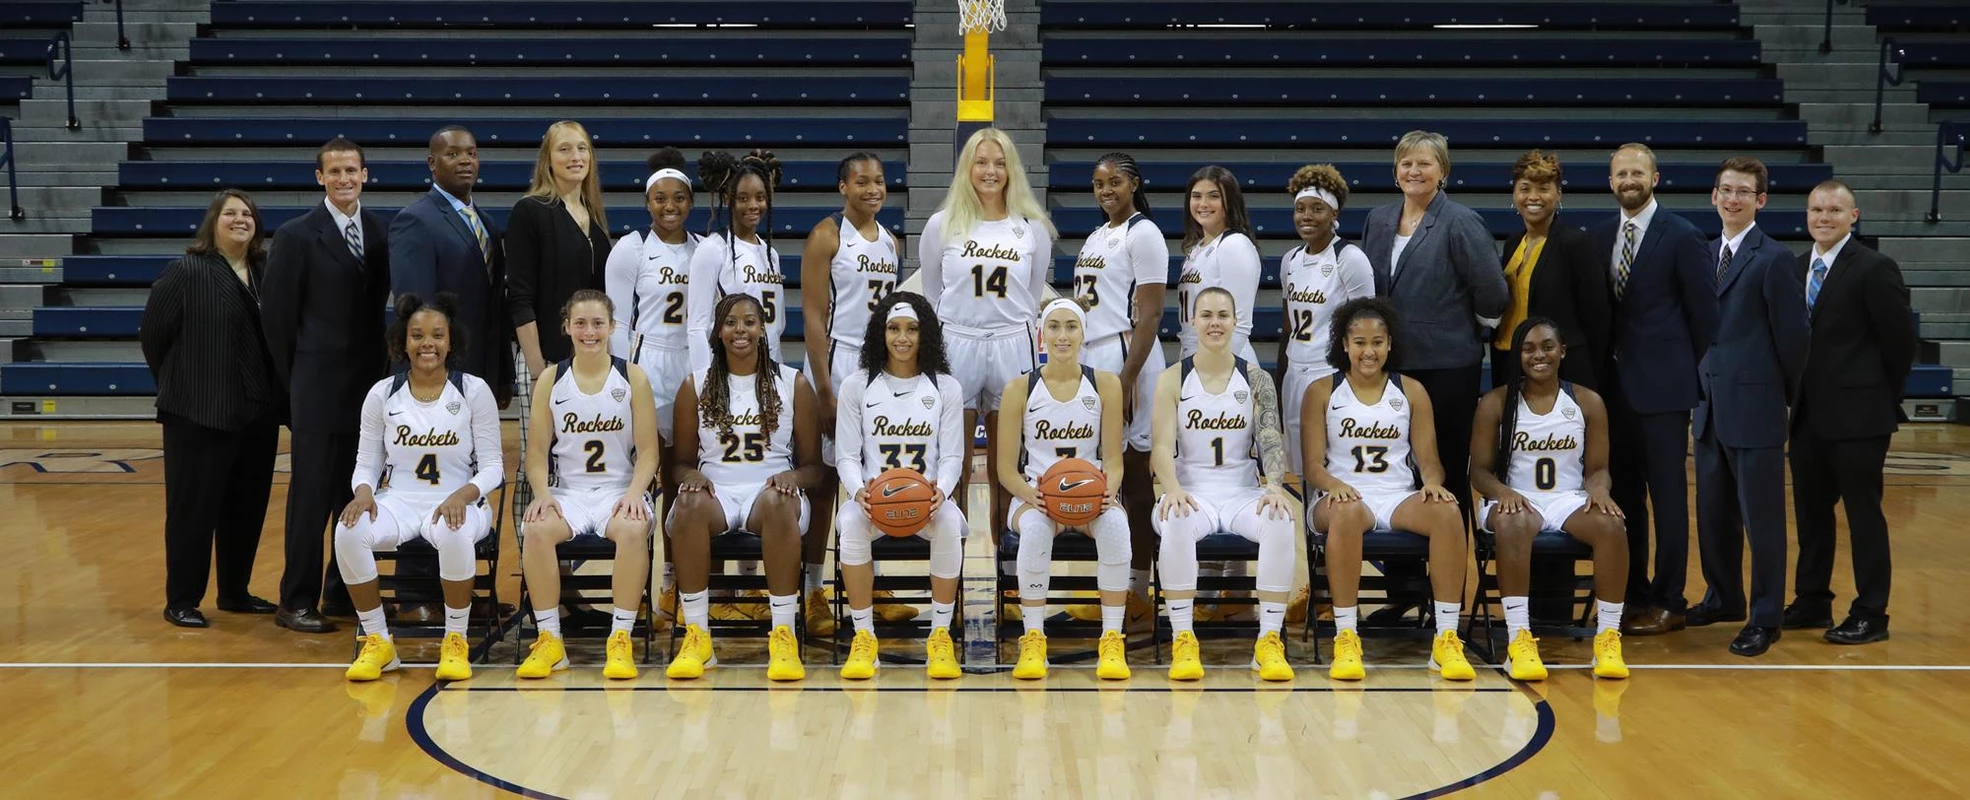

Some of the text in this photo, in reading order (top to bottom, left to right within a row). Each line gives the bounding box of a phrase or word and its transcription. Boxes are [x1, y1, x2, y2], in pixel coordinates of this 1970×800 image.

[960, 240, 1021, 263] Rockets
[971, 264, 1008, 298] 14
[663, 291, 688, 324] 2
[1291, 309, 1312, 341] 12
[562, 412, 625, 434] Rockets
[871, 415, 933, 437] Rockets
[1034, 419, 1094, 441] Rockets
[1185, 409, 1247, 431] Rockets
[1338, 417, 1401, 440] Rockets
[393, 424, 459, 447] Rockets
[719, 432, 765, 463] 25
[1512, 431, 1578, 452] Rockets
[584, 440, 606, 473] 2
[879, 443, 927, 474] 33
[1211, 437, 1226, 466] 1
[1350, 445, 1389, 473] 13
[415, 453, 440, 485] 4
[1535, 457, 1556, 490] 0
